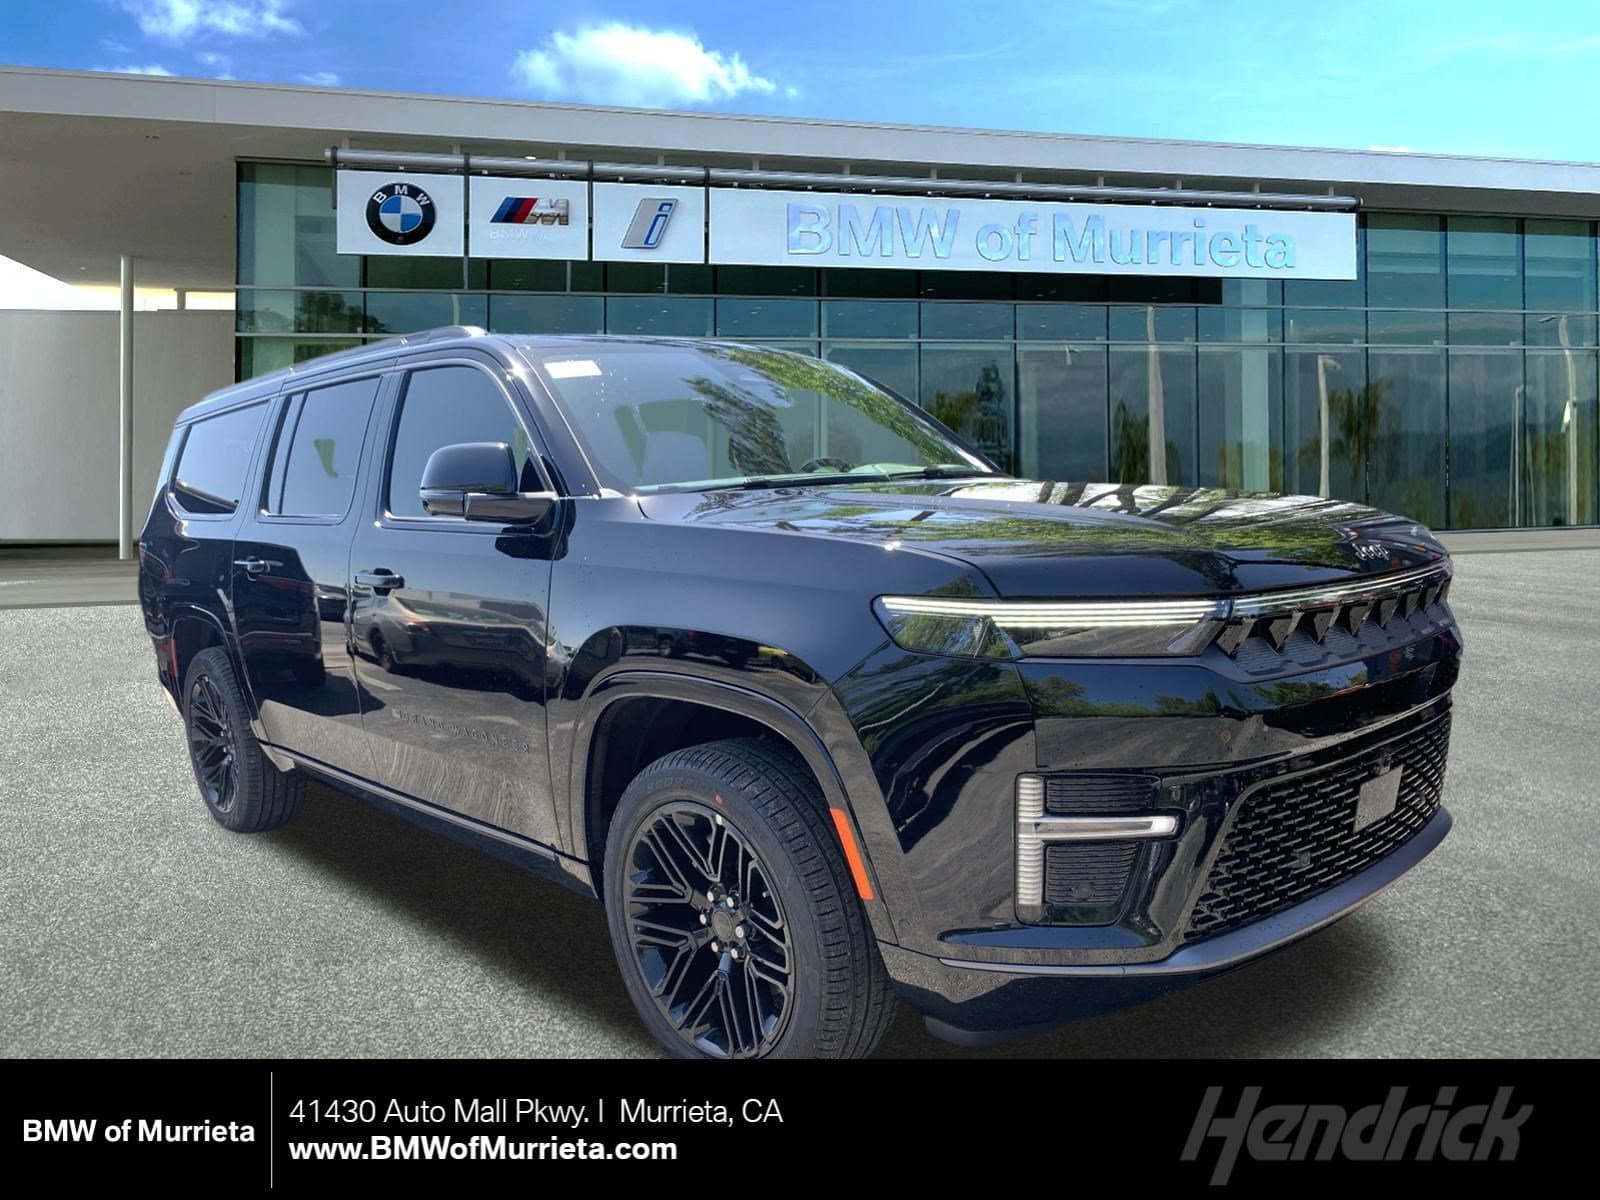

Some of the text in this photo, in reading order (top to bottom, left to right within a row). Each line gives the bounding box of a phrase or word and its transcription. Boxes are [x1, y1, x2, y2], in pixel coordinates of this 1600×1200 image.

[371, 184, 431, 206] BMW
[787, 203, 1296, 269] BMW of Murrieta
